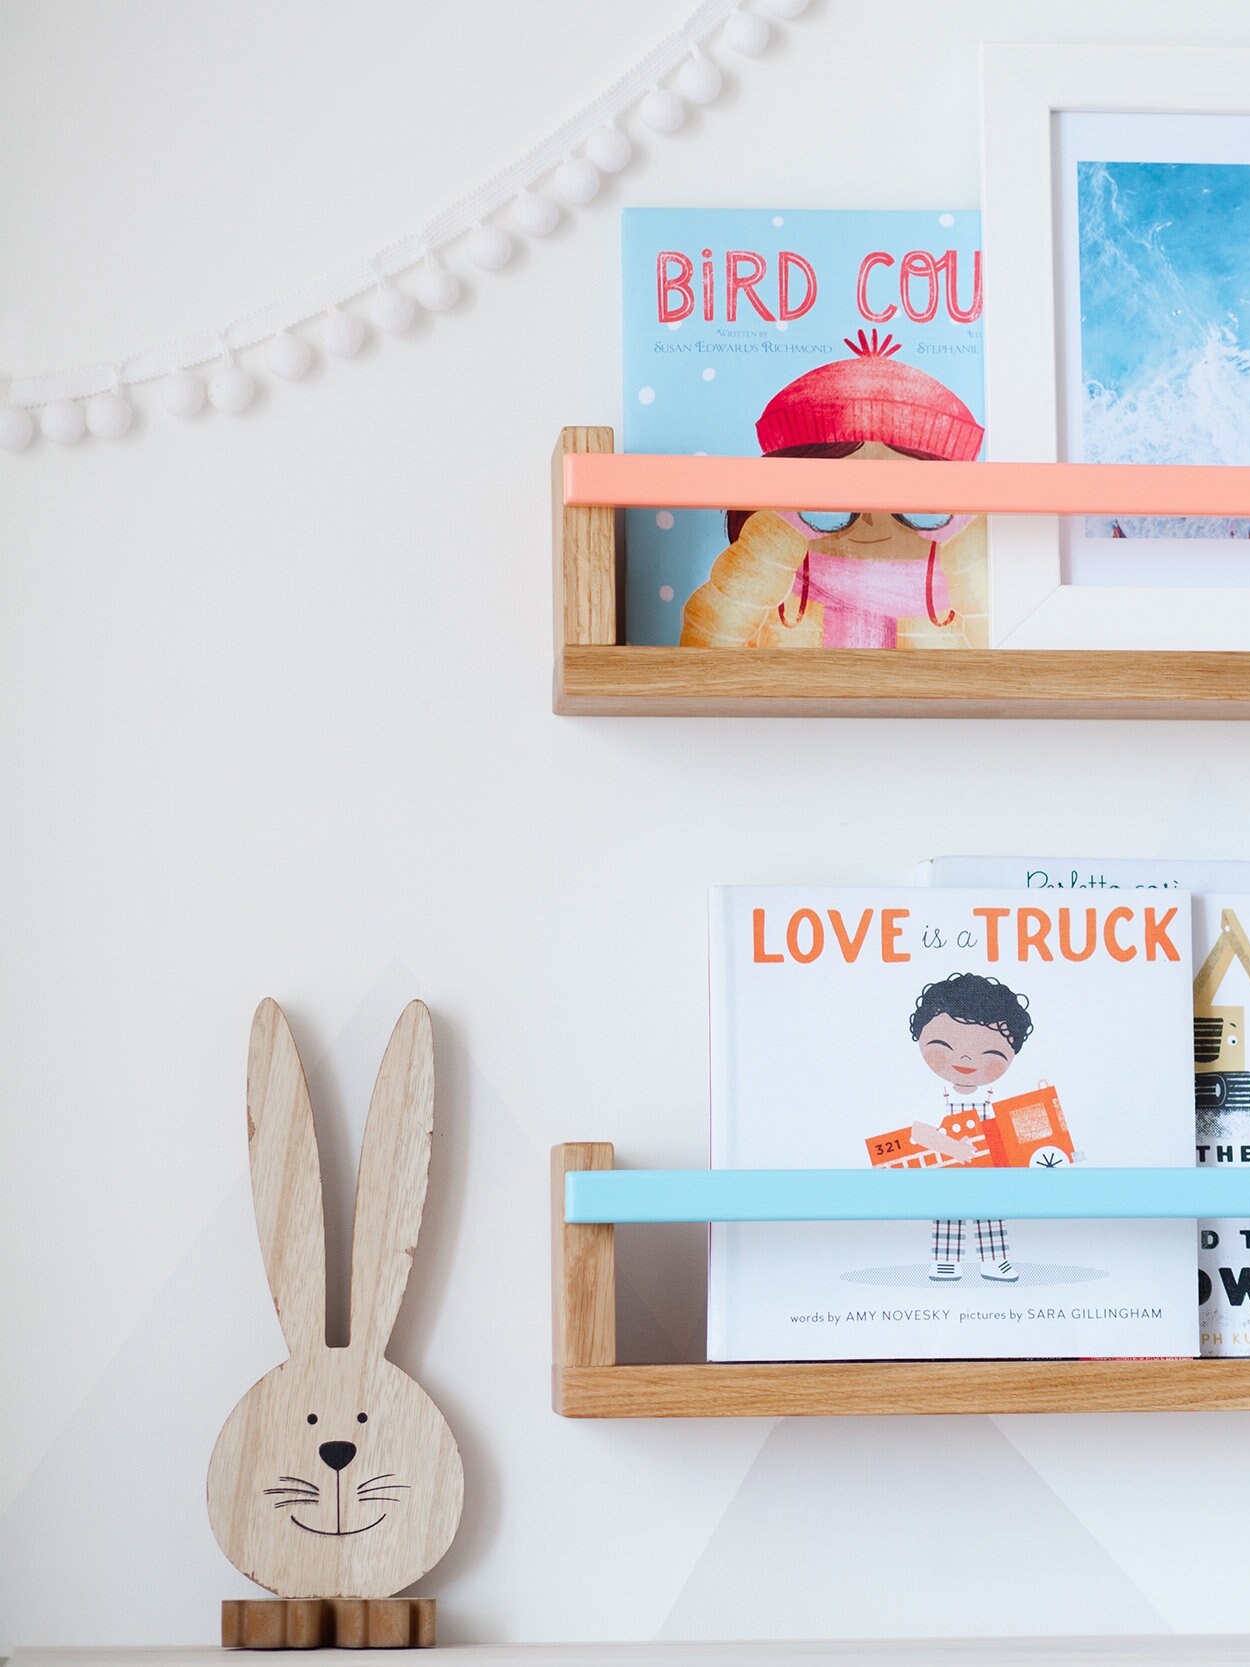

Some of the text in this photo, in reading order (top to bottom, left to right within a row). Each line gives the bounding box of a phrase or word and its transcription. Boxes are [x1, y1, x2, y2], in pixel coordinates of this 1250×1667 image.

[752, 906, 1181, 964] LOVE is a TRUCK
[875, 1139, 902, 1156] 321
[1201, 1230, 1220, 1250] D
[790, 1309, 951, 1326] words by AMY NOVESKY
[959, 1307, 1163, 1324] pictures by SARA GILLINGHAM
[1201, 1333, 1223, 1345] PH
